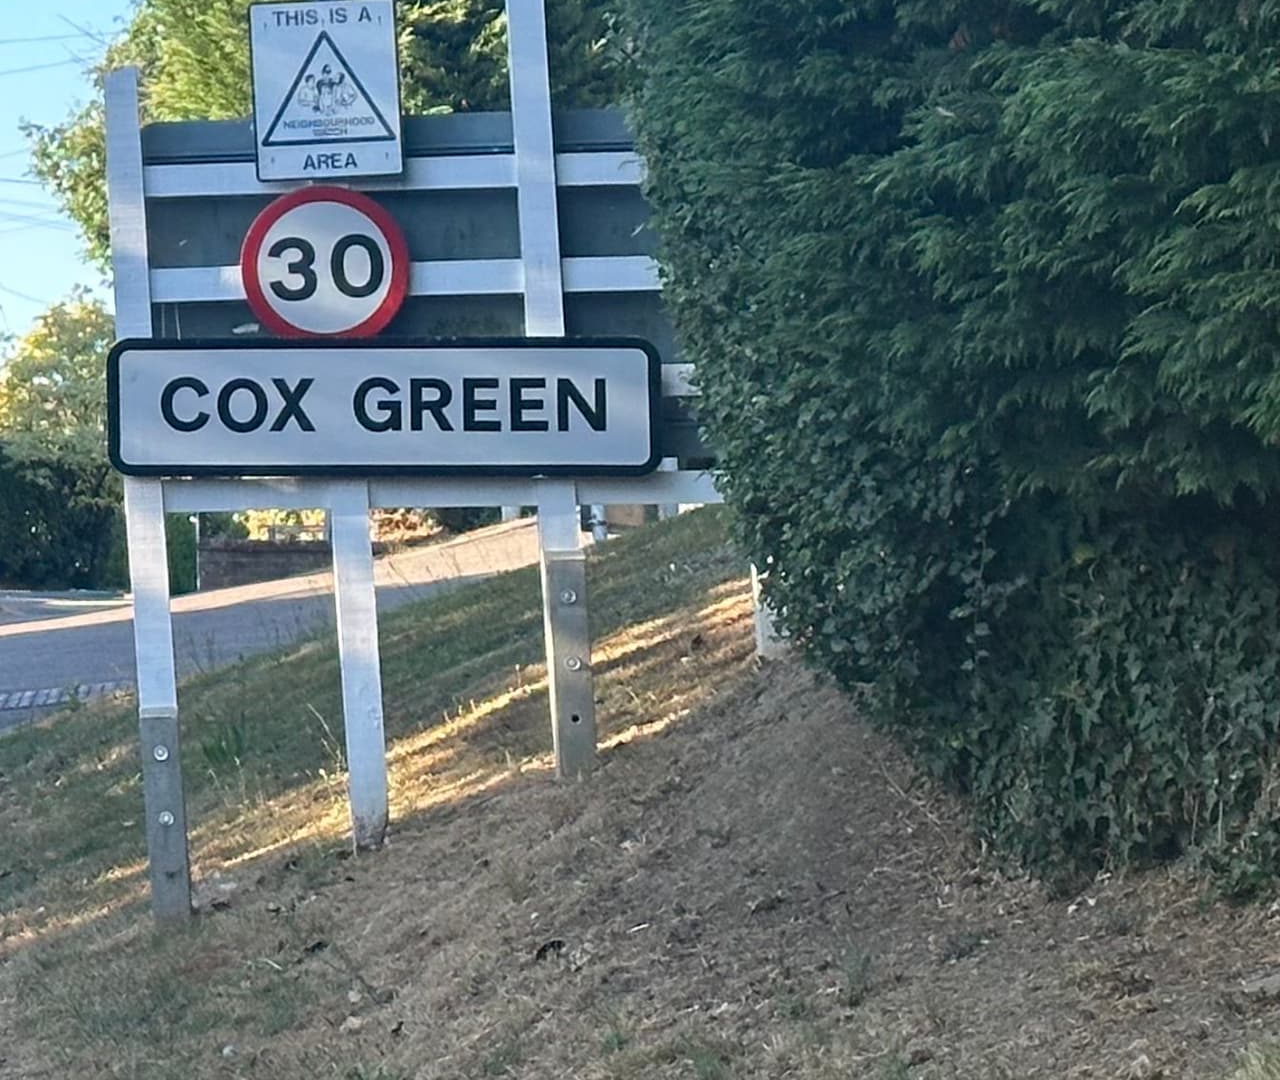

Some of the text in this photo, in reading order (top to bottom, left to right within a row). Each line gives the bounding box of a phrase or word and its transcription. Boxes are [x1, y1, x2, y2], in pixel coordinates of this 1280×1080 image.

[272, 6, 372, 27] THIS IS A
[302, 152, 358, 171] AREA
[267, 233, 385, 302] 30
[160, 376, 607, 434] COX GREEN
